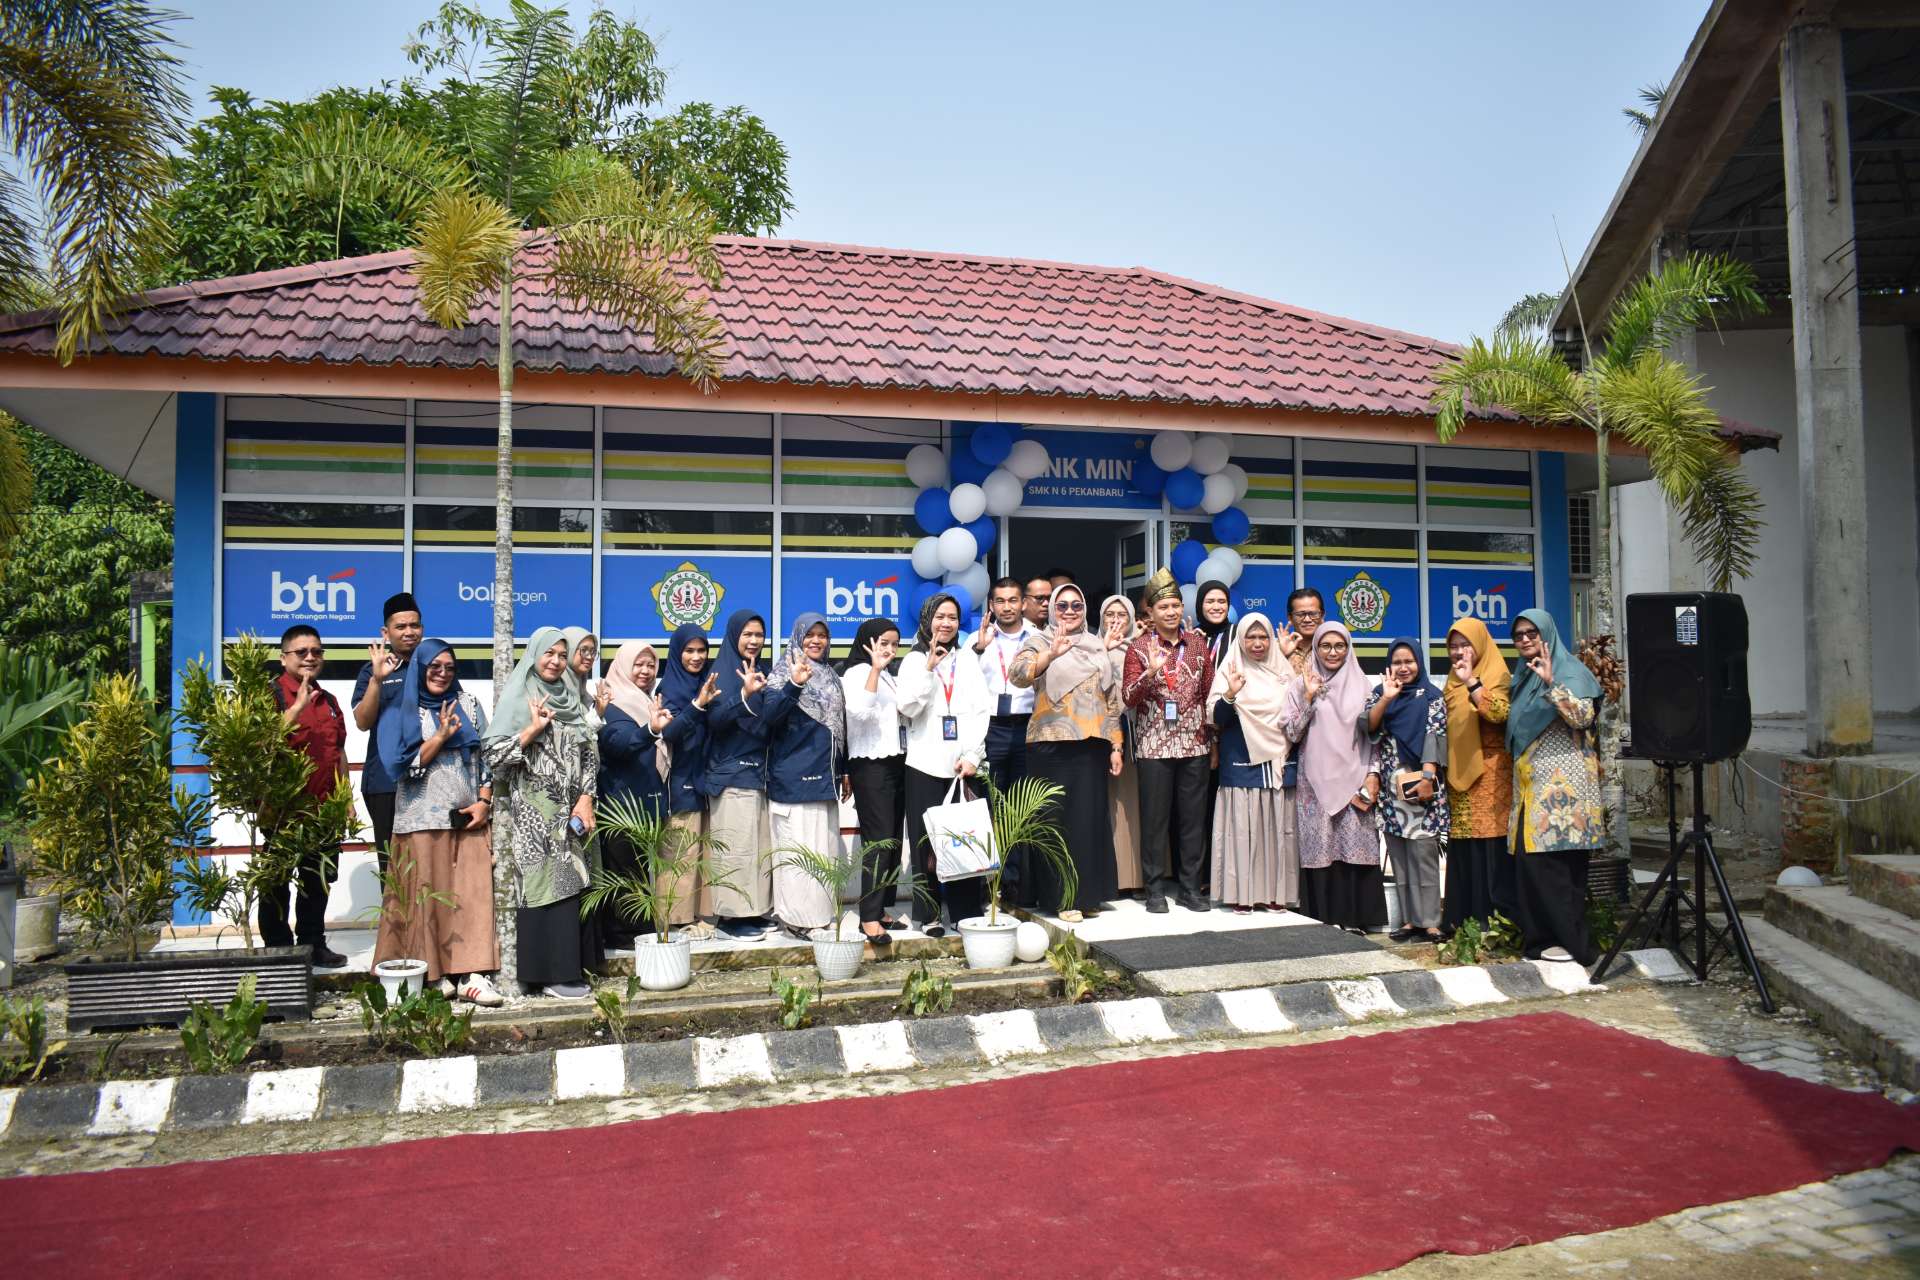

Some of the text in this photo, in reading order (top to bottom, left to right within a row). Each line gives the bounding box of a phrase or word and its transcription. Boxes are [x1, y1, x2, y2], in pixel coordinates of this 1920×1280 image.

[1085, 458, 1136, 480] MIN
[1028, 486, 1124, 497] SMK N 6 PEKANBARU
[271, 568, 356, 612] btn
[458, 582, 495, 601] bal
[825, 576, 899, 616] btn
[1452, 583, 1508, 619] btn
[291, 613, 328, 621] Tabungan
